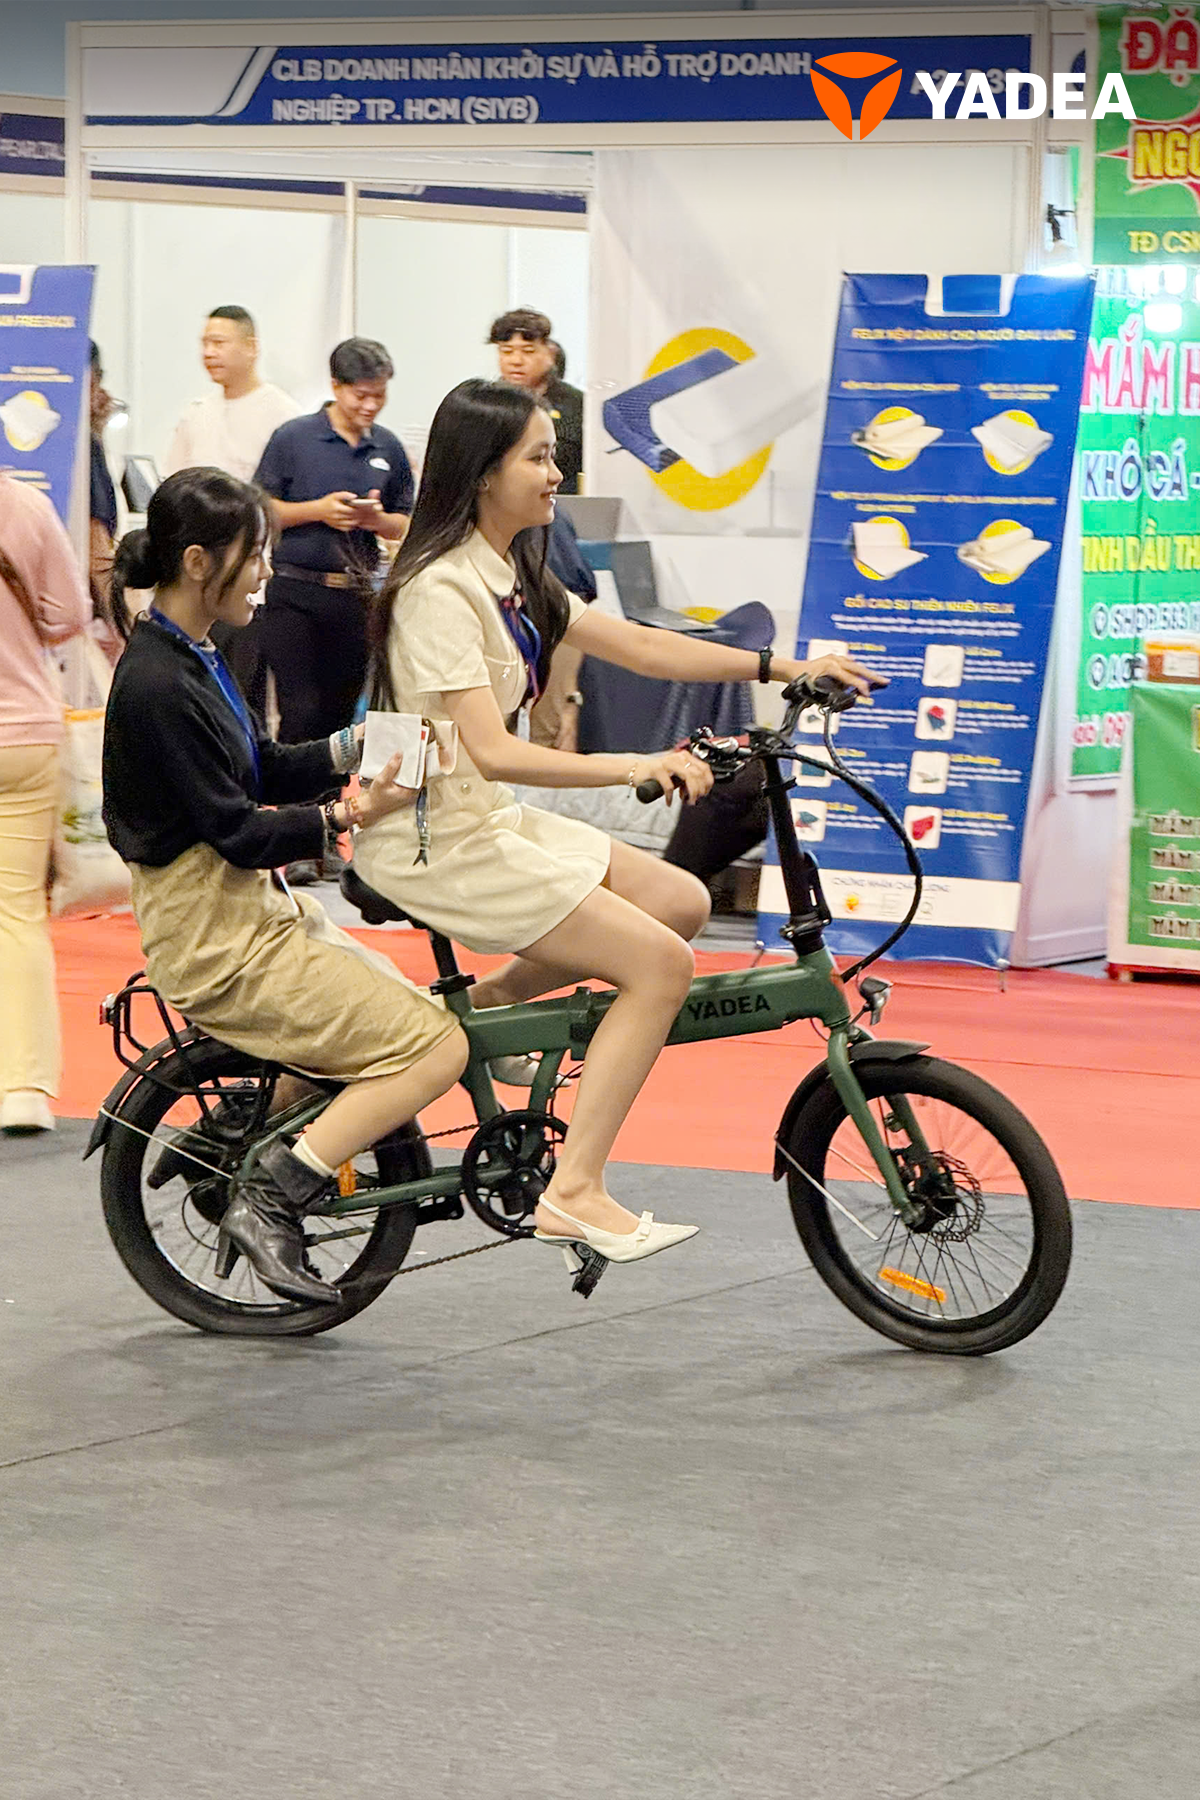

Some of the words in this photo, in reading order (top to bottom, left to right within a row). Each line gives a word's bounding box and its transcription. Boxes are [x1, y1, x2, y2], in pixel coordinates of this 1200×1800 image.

[272, 58, 323, 81] CLB
[323, 57, 409, 81] DOANH
[412, 52, 482, 79] NHÂN
[547, 52, 584, 85] SỰ
[585, 48, 620, 78] VÀ
[622, 43, 662, 78] HỖ
[664, 50, 718, 83] TRỢ
[721, 51, 812, 77] DOANH
[272, 93, 360, 126] NGHIỆP
[361, 98, 401, 121] TP.
[404, 98, 460, 121] HCM
[462, 95, 540, 125] (SIYB)
[687, 994, 771, 1022] YADEA
